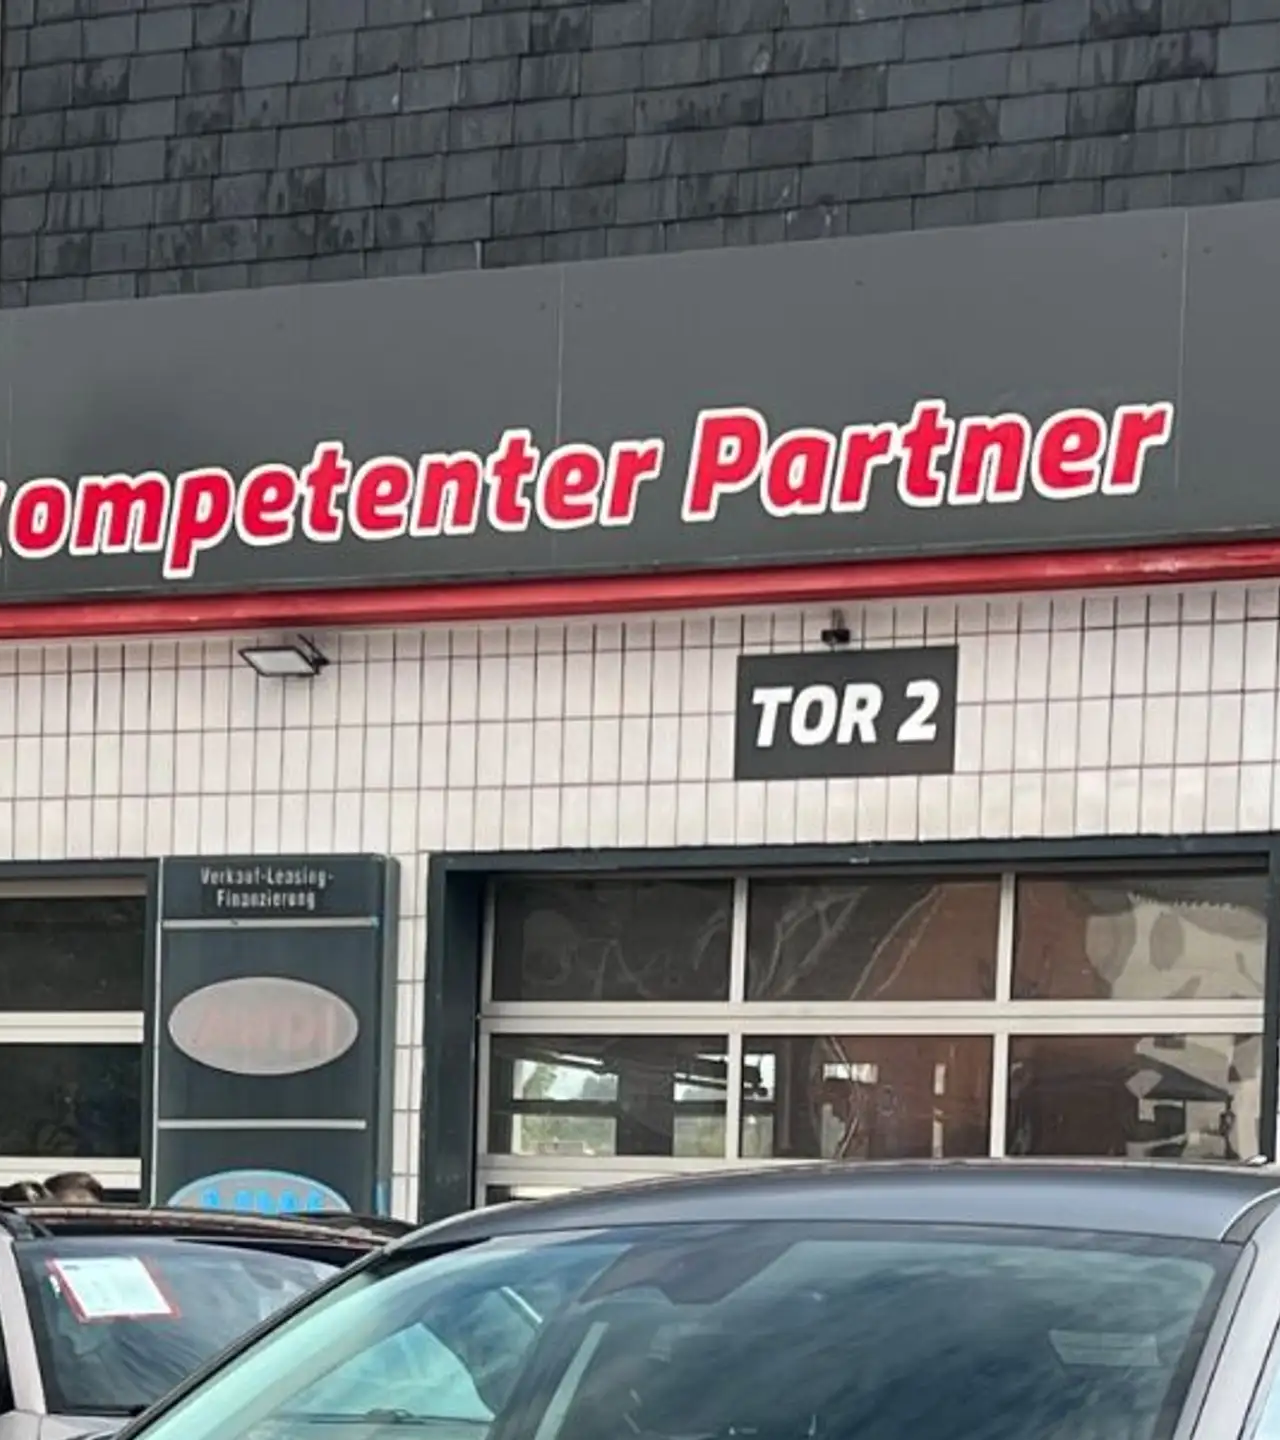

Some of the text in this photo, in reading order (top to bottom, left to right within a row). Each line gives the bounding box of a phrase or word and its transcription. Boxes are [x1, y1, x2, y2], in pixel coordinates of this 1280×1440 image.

[682, 399, 1173, 522] Partner
[751, 679, 940, 748] TOR 2
[216, 888, 316, 910] Finanzierung
